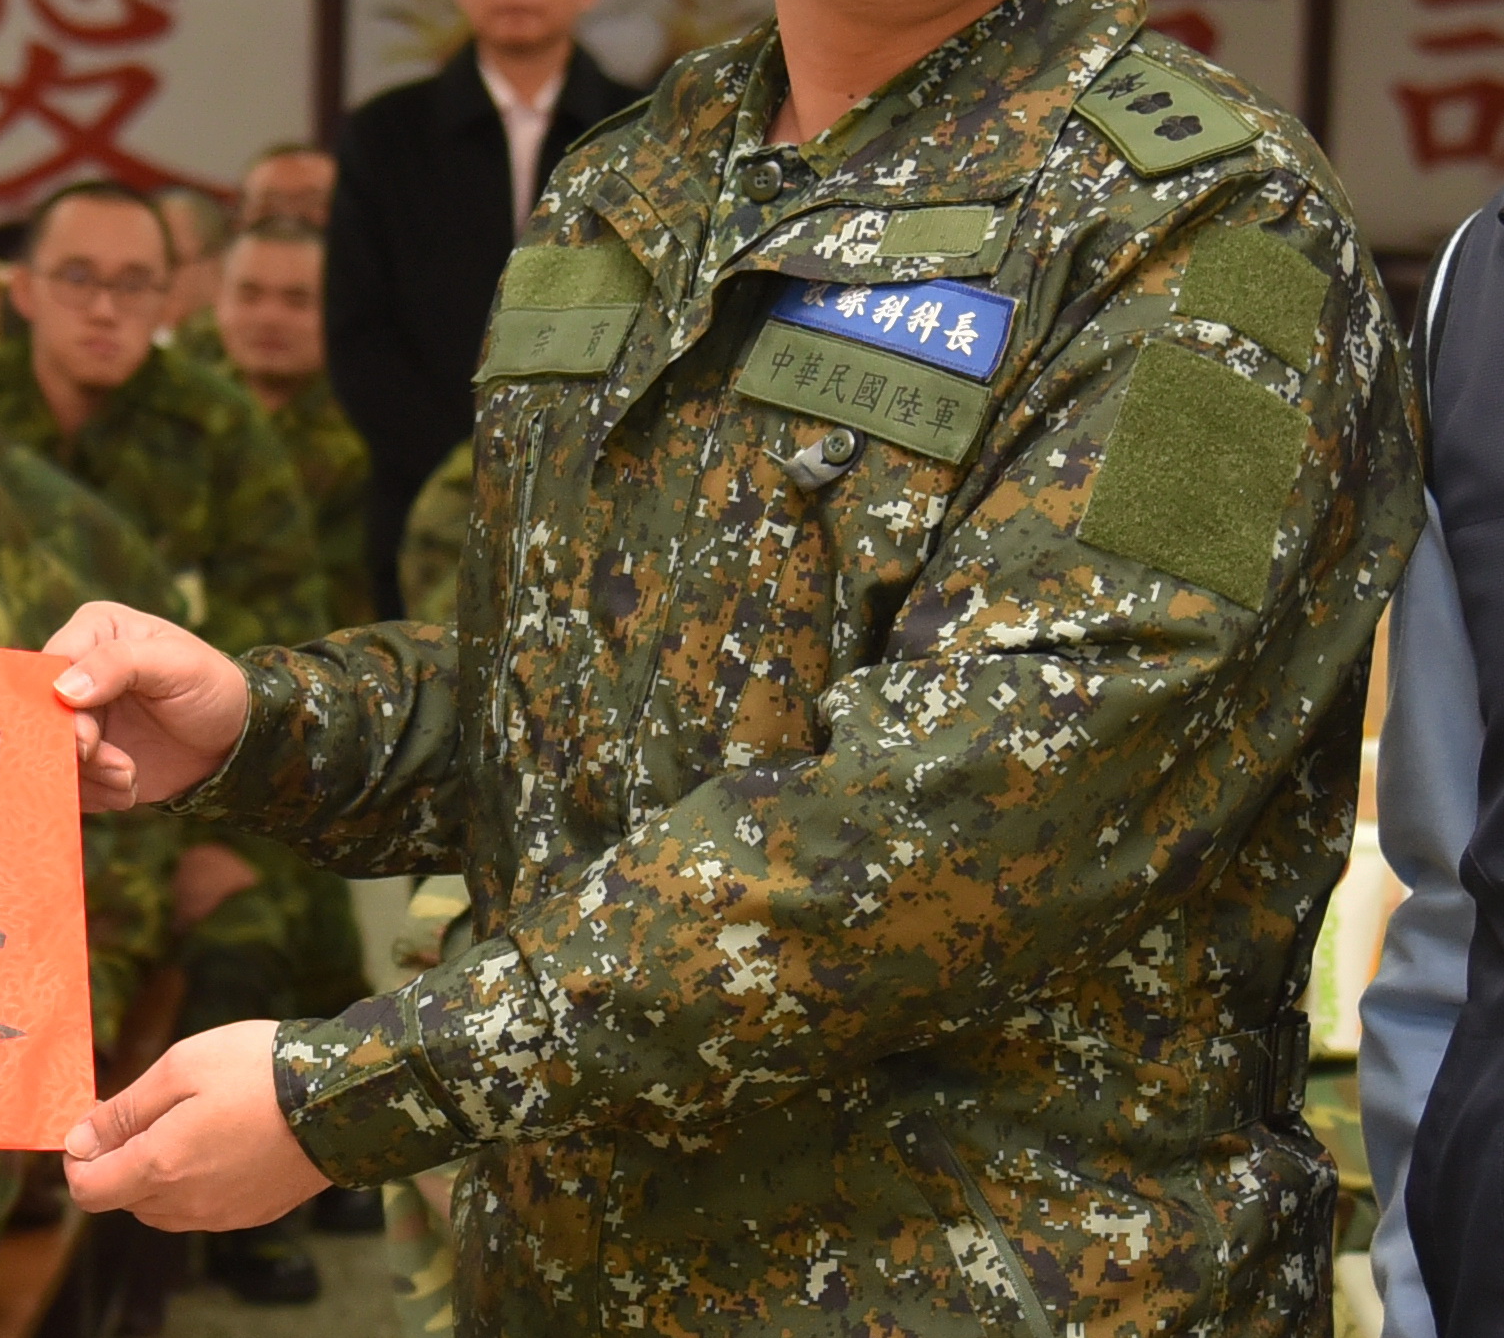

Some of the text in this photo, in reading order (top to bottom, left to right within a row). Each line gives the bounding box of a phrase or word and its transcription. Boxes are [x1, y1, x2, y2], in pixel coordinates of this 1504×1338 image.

[493, 318, 611, 359] 宗育
[770, 343, 961, 439] 中華民國陸軍
